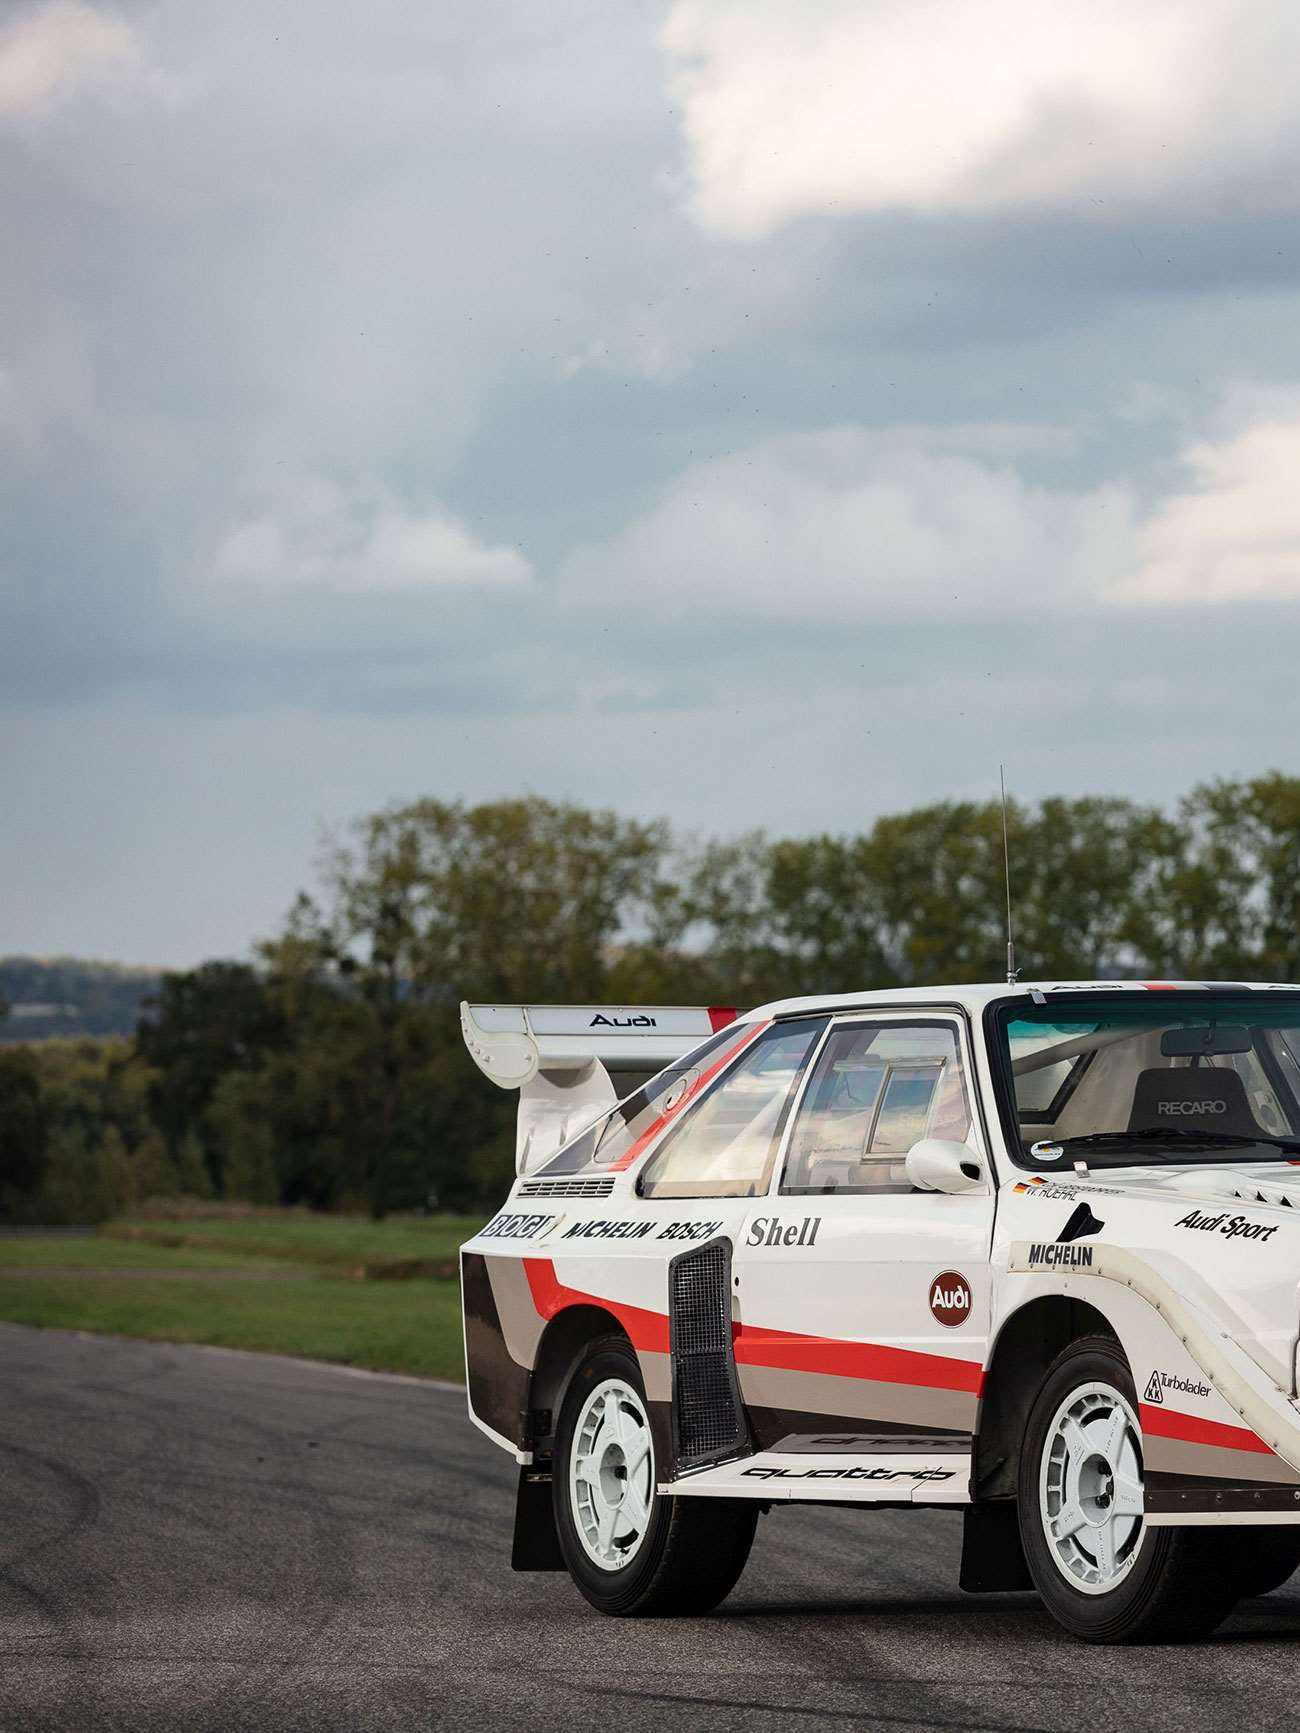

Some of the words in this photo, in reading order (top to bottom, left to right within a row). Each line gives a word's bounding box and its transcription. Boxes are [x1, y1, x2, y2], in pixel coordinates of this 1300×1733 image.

[589, 1013, 657, 1027] Audi
[1157, 1100, 1227, 1116] RECARO
[560, 1220, 657, 1239] MICHELIN
[656, 1221, 724, 1239] BOSCH
[745, 1216, 823, 1247] Shell
[1174, 1209, 1231, 1232] Audi
[1220, 1215, 1281, 1242] Sport
[1028, 1243, 1094, 1267] MICHELIN
[931, 1284, 970, 1309] Audi
[1161, 1372, 1212, 1397] Turbolader
[740, 1466, 957, 1481] quattro
